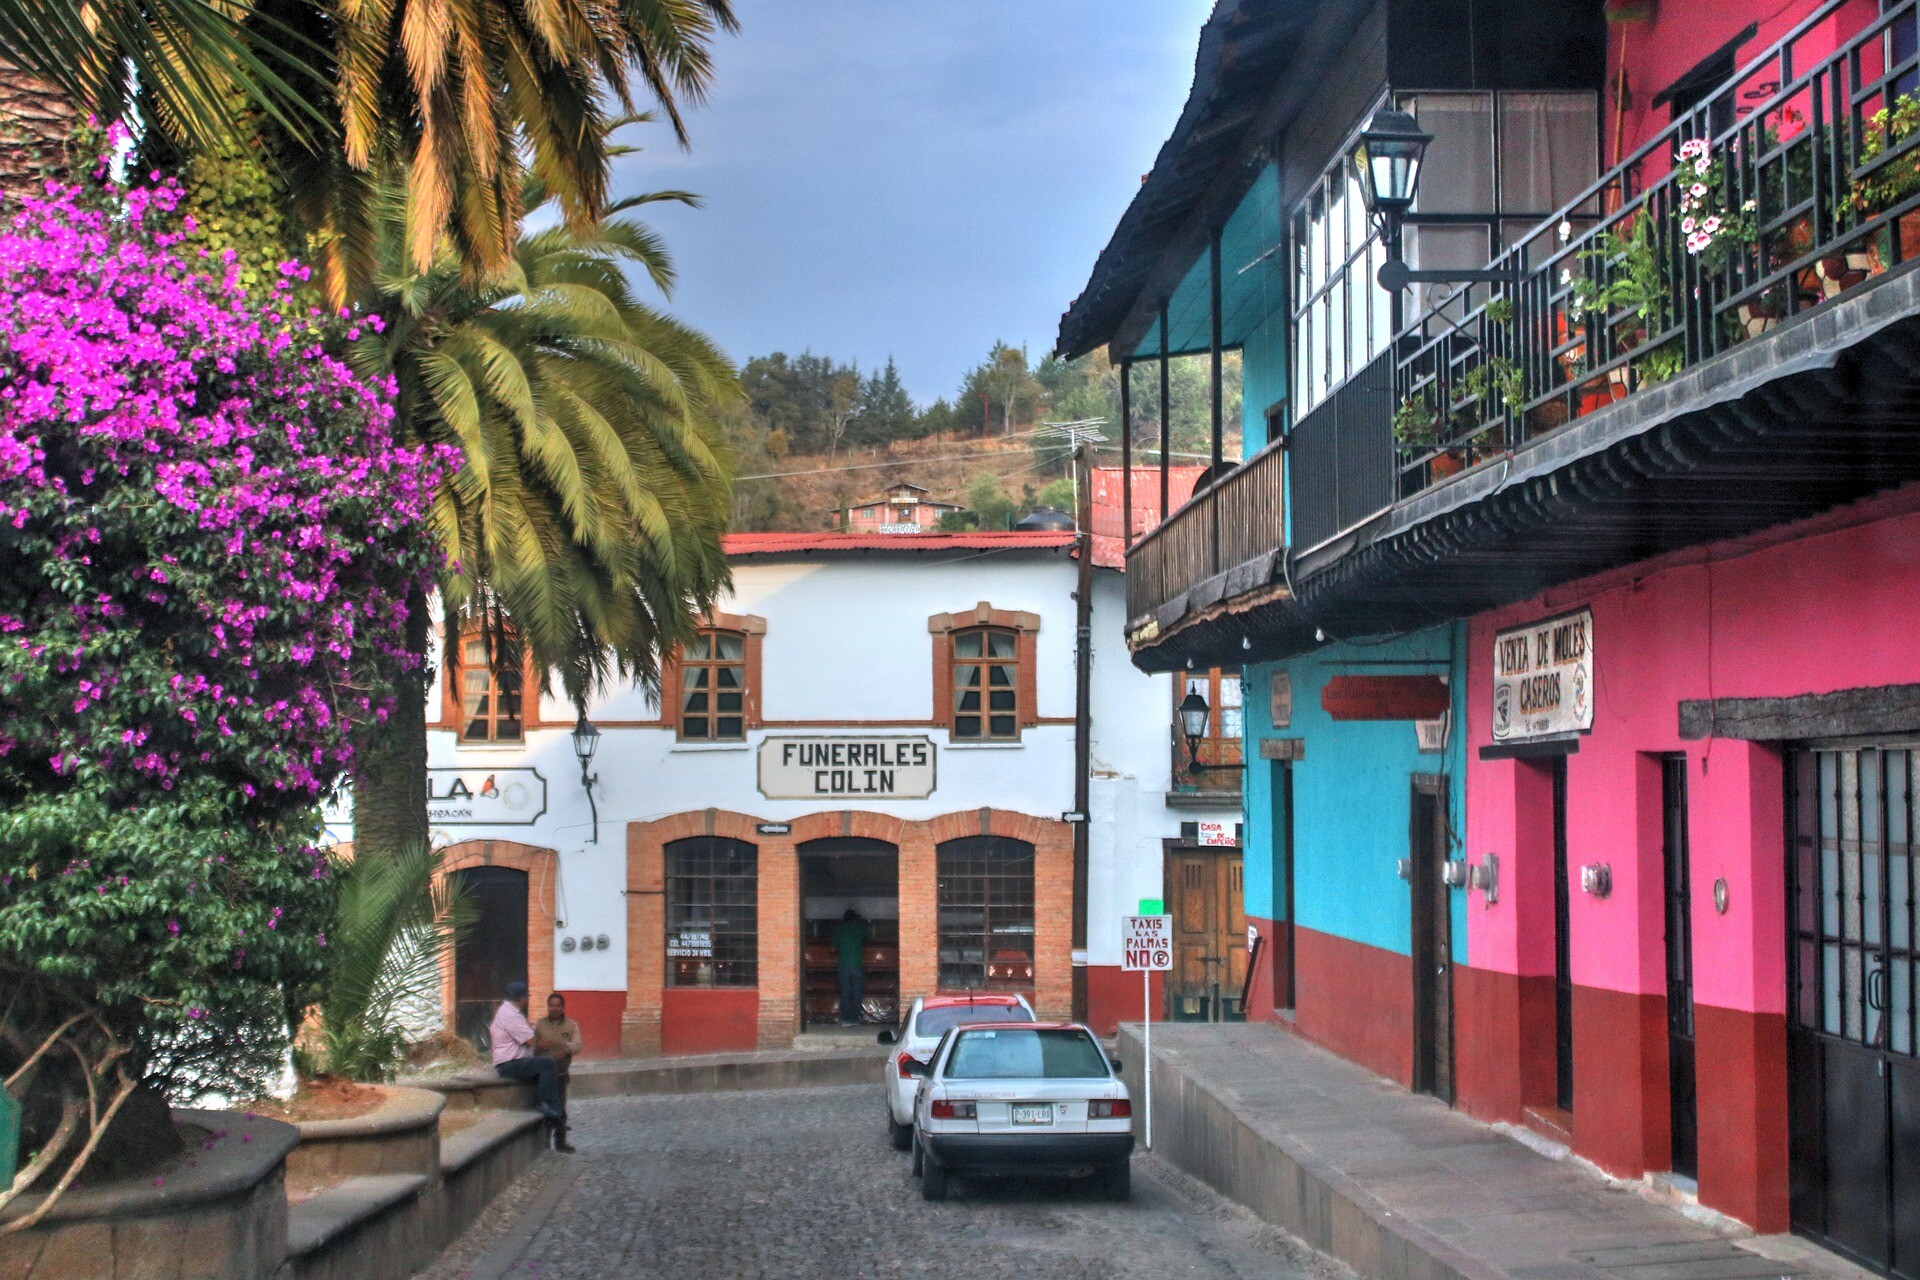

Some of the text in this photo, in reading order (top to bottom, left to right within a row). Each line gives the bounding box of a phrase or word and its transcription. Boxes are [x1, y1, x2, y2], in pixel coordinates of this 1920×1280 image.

[1499, 619, 1586, 675] VENTA DE MOLES
[1520, 672, 1561, 714] CASEROS
[783, 743, 927, 767] FUNERALES
[1201, 823, 1222, 831] CASA
[1130, 919, 1162, 930] TAXIS
[1126, 938, 1168, 949] PALMAS
[1126, 950, 1151, 968] NO
